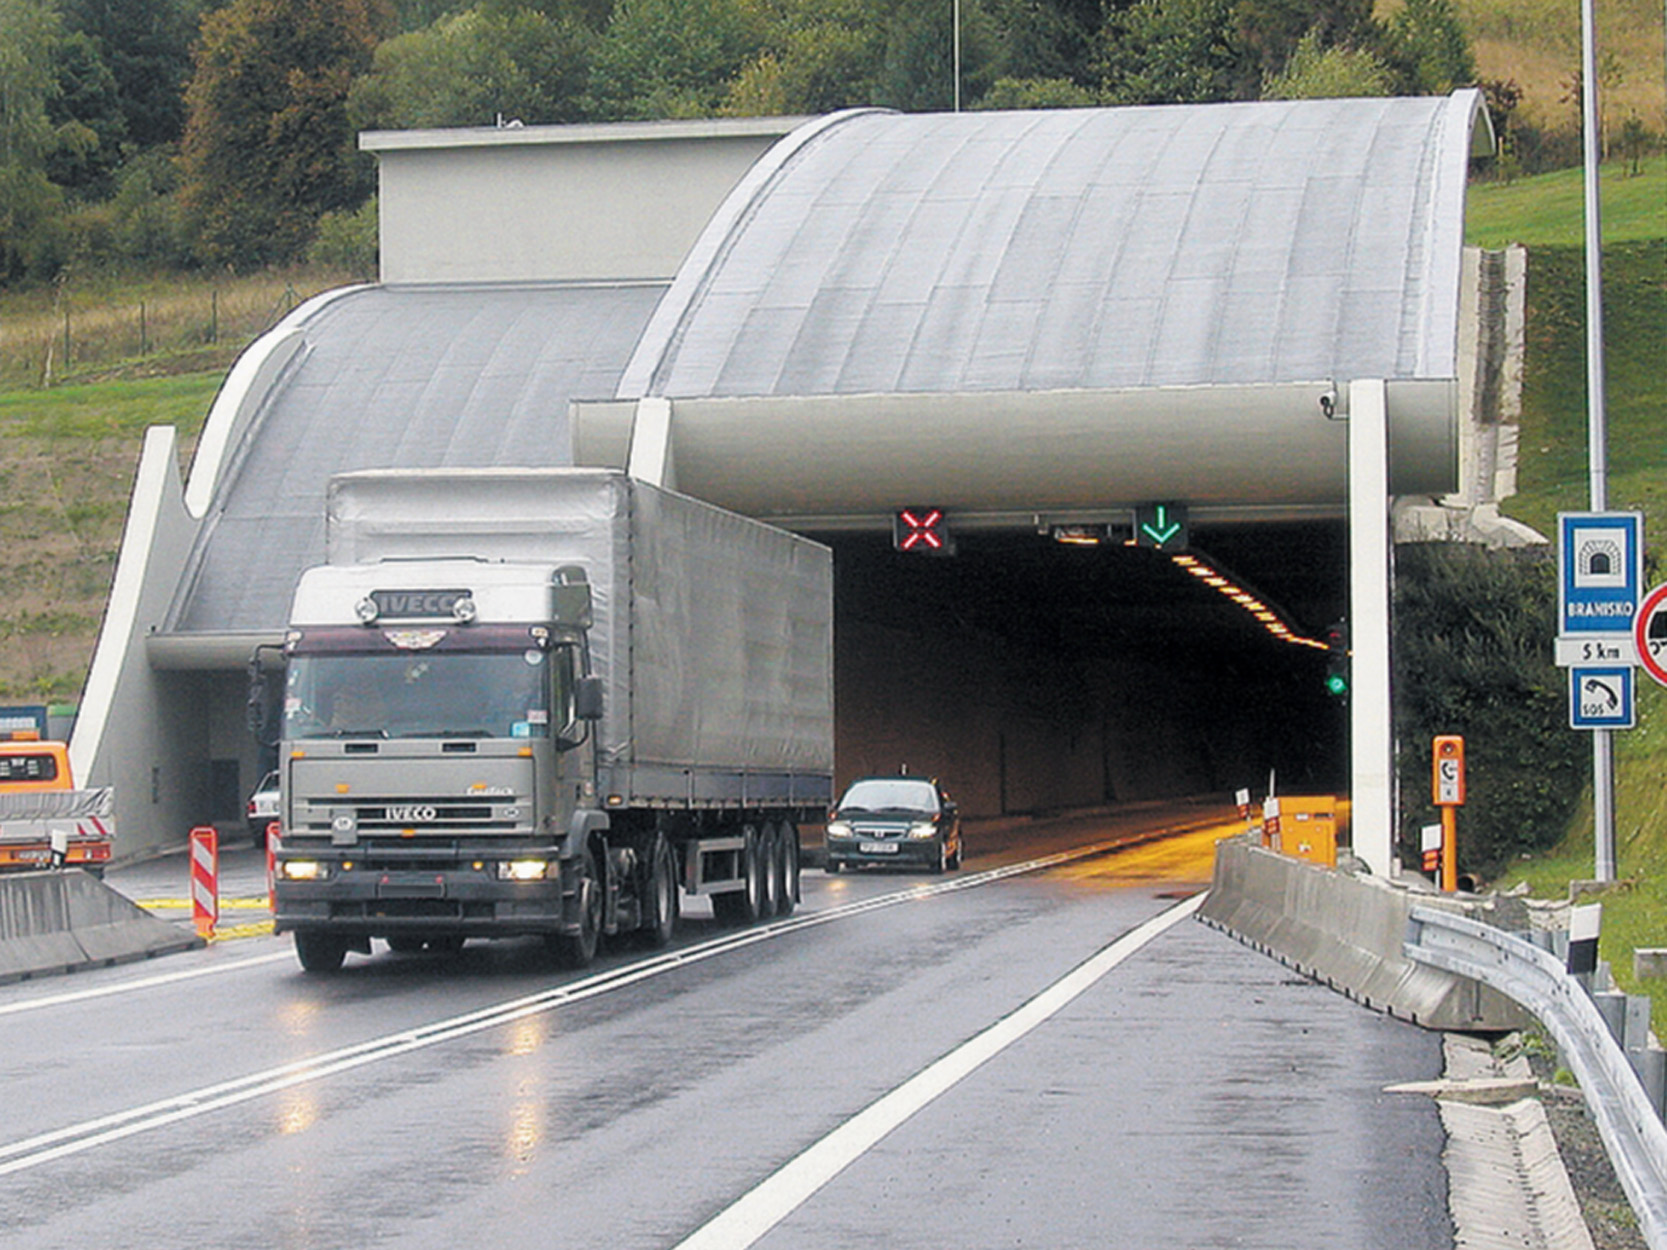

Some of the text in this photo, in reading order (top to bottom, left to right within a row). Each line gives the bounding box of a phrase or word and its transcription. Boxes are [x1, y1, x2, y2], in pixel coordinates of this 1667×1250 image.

[1568, 602, 1633, 617] BRANISKO
[1597, 643, 1619, 659] km
[1583, 703, 1604, 715] SOS
[385, 806, 436, 820] IVECO
